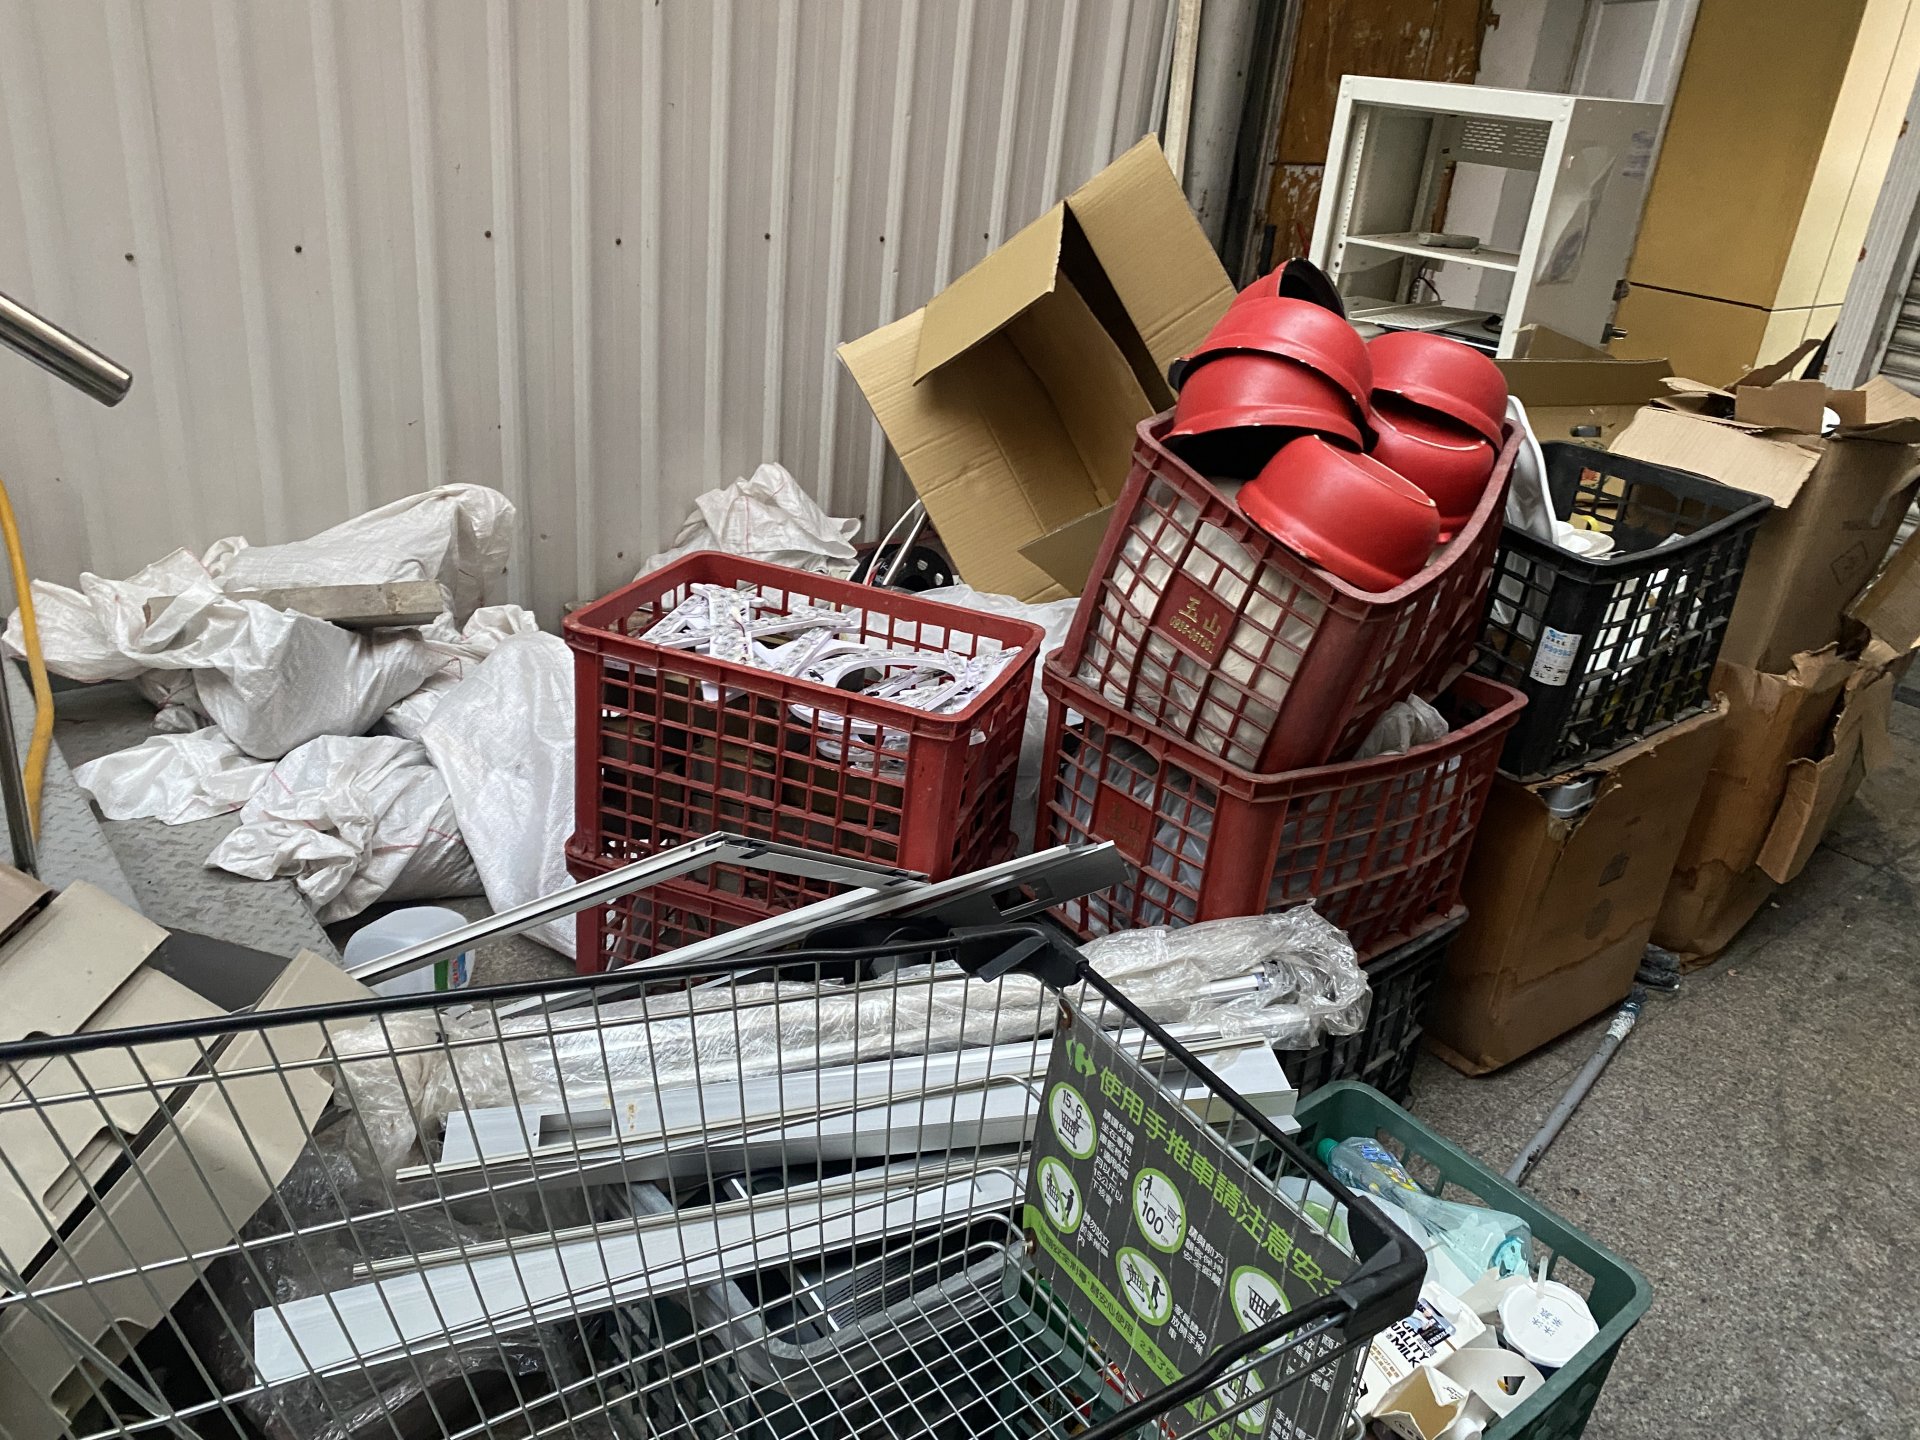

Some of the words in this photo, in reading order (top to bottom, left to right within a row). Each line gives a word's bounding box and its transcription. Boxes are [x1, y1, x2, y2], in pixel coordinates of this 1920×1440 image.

[1062, 1090, 1072, 1109] 15
[1076, 1103, 1083, 1120] 6
[1141, 1200, 1164, 1235] 100
[1391, 1322, 1429, 1361] UALITY
[1391, 1336, 1421, 1369] MILK
